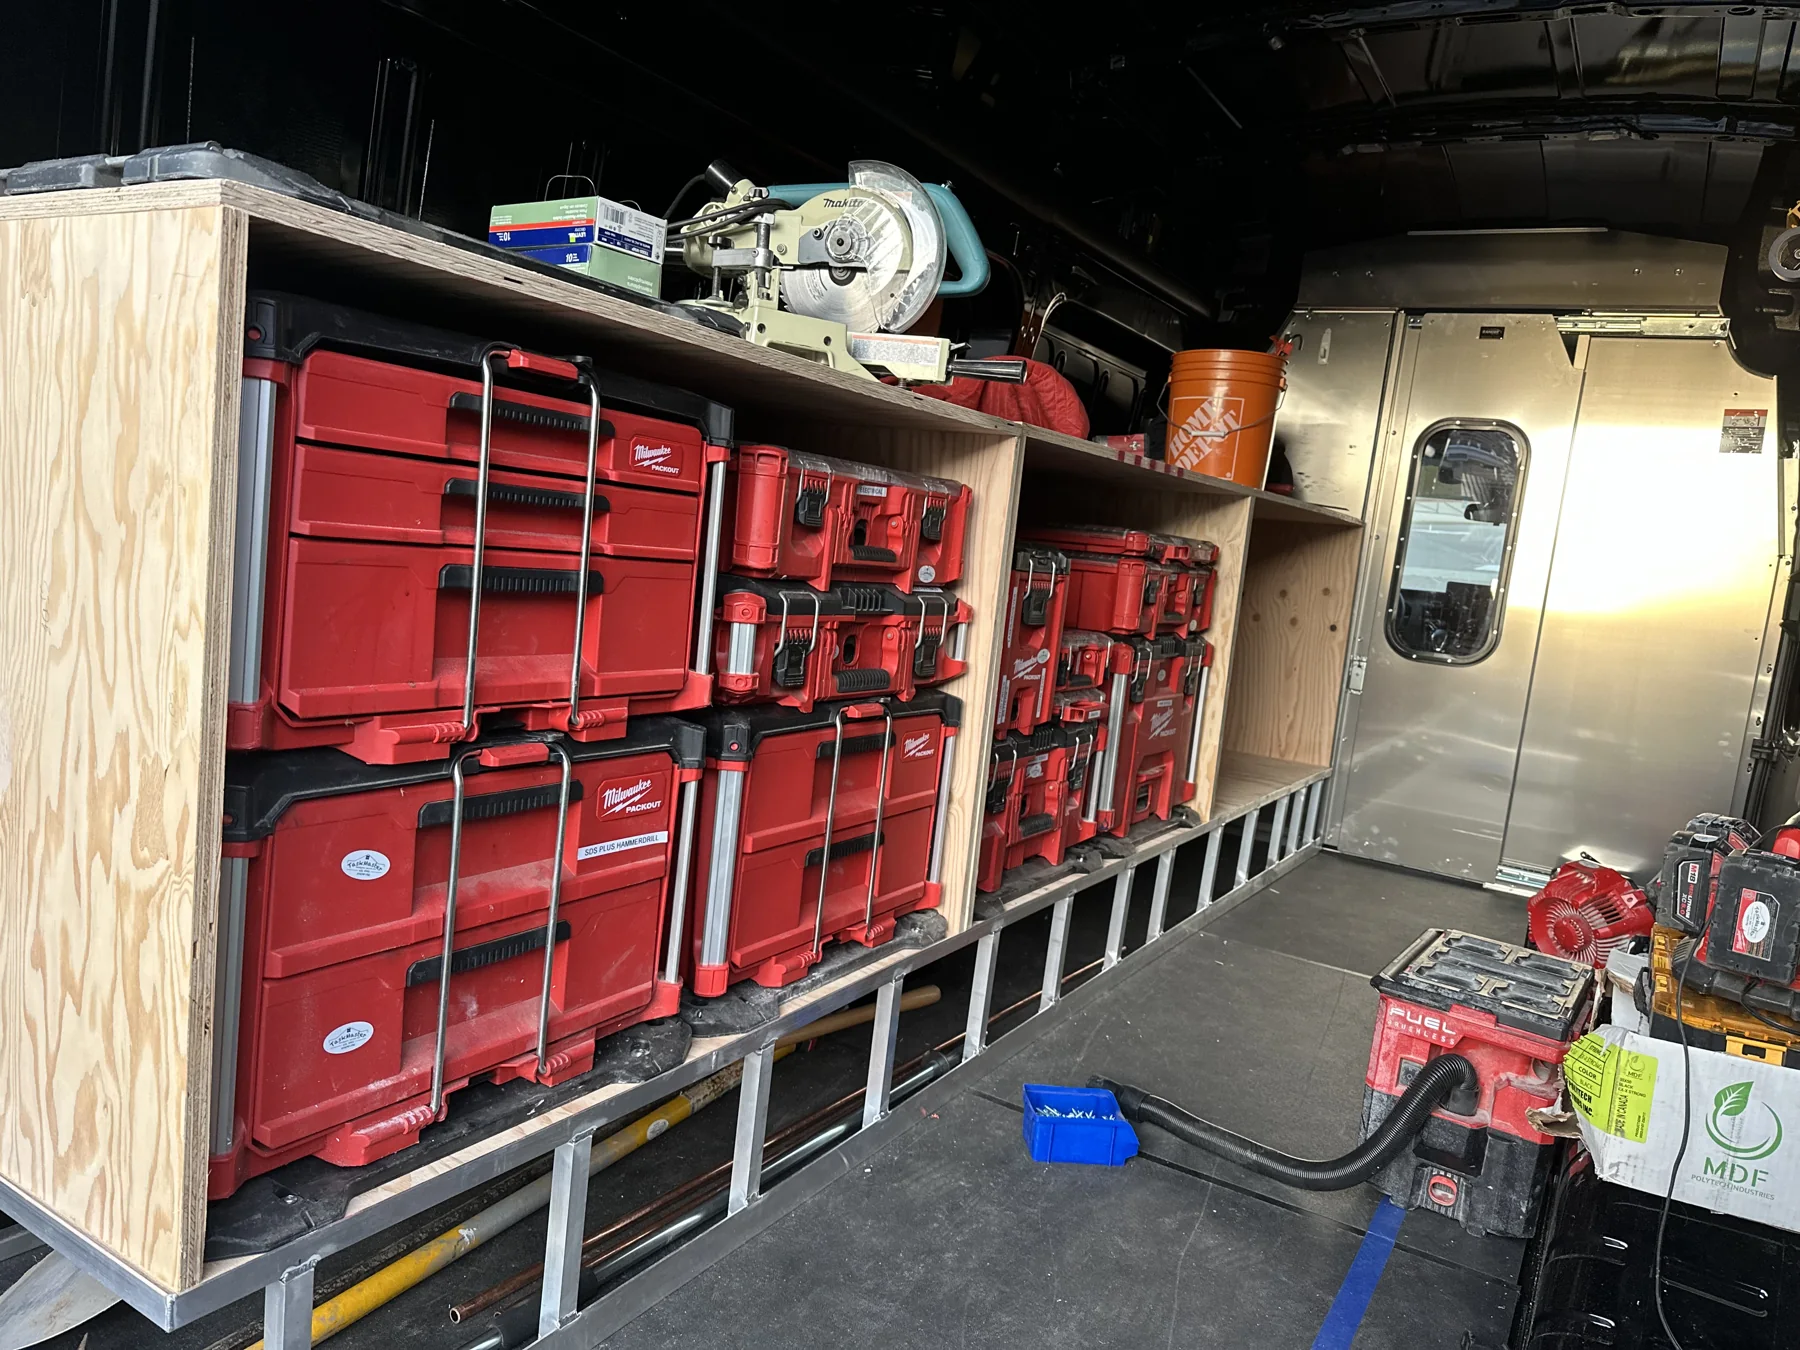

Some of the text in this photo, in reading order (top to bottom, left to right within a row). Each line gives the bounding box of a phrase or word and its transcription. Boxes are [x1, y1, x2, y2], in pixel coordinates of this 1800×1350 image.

[1169, 398, 1225, 459] HOME
[1174, 410, 1240, 471] DEPOT
[634, 444, 672, 461] Milwaukee
[651, 464, 680, 474] PACKOUT
[904, 732, 930, 754] Milwaukee
[914, 748, 935, 757] PACKOUT
[601, 779, 652, 810] Milwaukee
[625, 800, 662, 814] PACKOUT
[584, 834, 659, 857] SDS PLUS HAMMERDRILL
[1689, 864, 1698, 883] M18
[1387, 1019, 1455, 1045] BRUSHLESS
[1390, 1007, 1456, 1035] FUEL
[1578, 1066, 1597, 1080] COLOR
[1703, 1156, 1769, 1187] MDF
